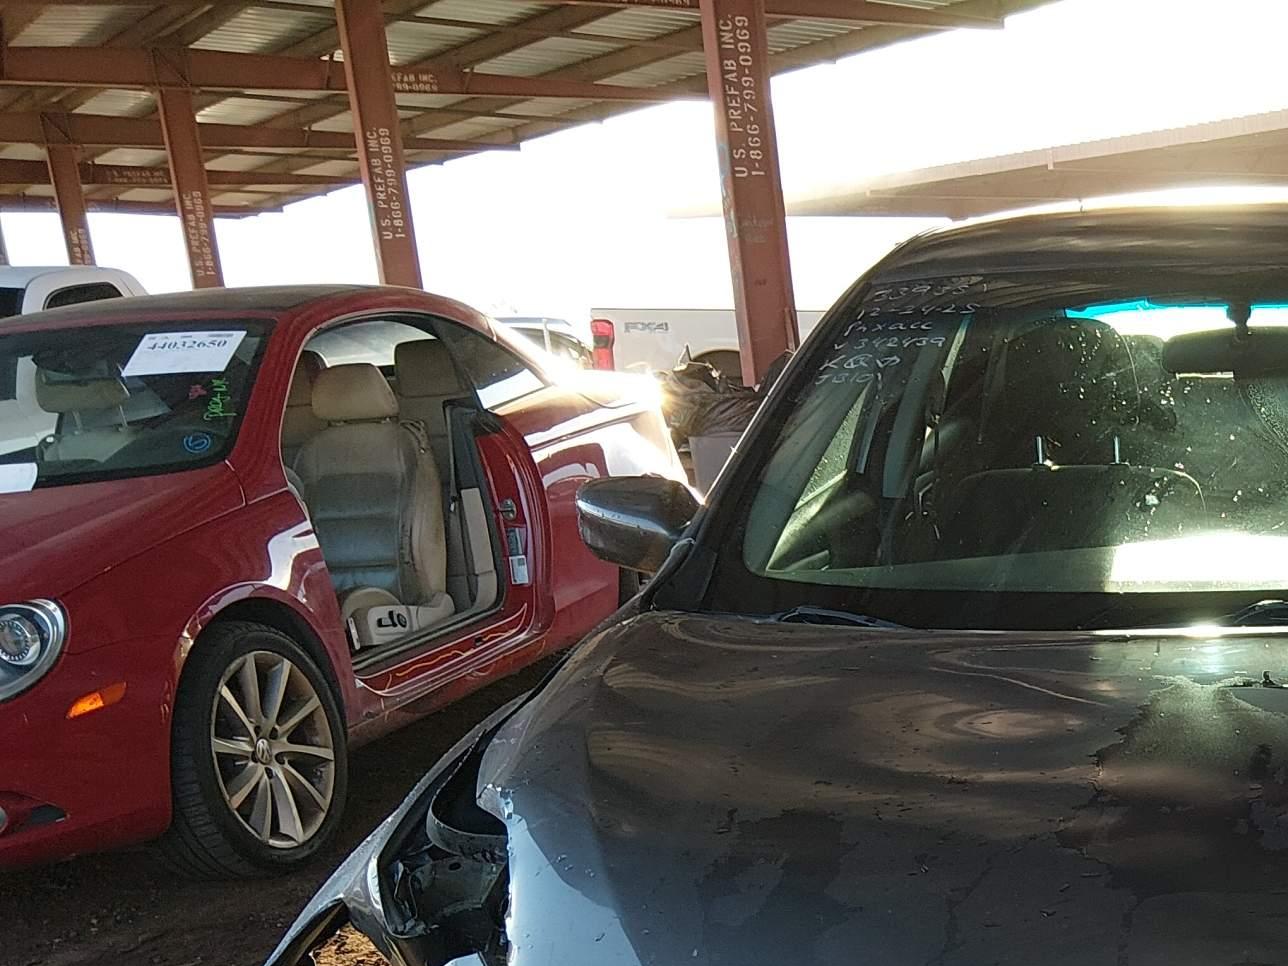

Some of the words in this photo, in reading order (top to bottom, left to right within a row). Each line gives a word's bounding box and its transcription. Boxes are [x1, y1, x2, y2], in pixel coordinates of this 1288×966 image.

[719, 14, 735, 49] INC.
[723, 59, 744, 132] PREFAB
[735, 16, 765, 176] 1-866-799-0969
[370, 158, 388, 208] PREFAB
[378, 128, 406, 238] 1-866-799-0969
[147, 339, 228, 351] 44032650
[623, 321, 669, 333] FX4
